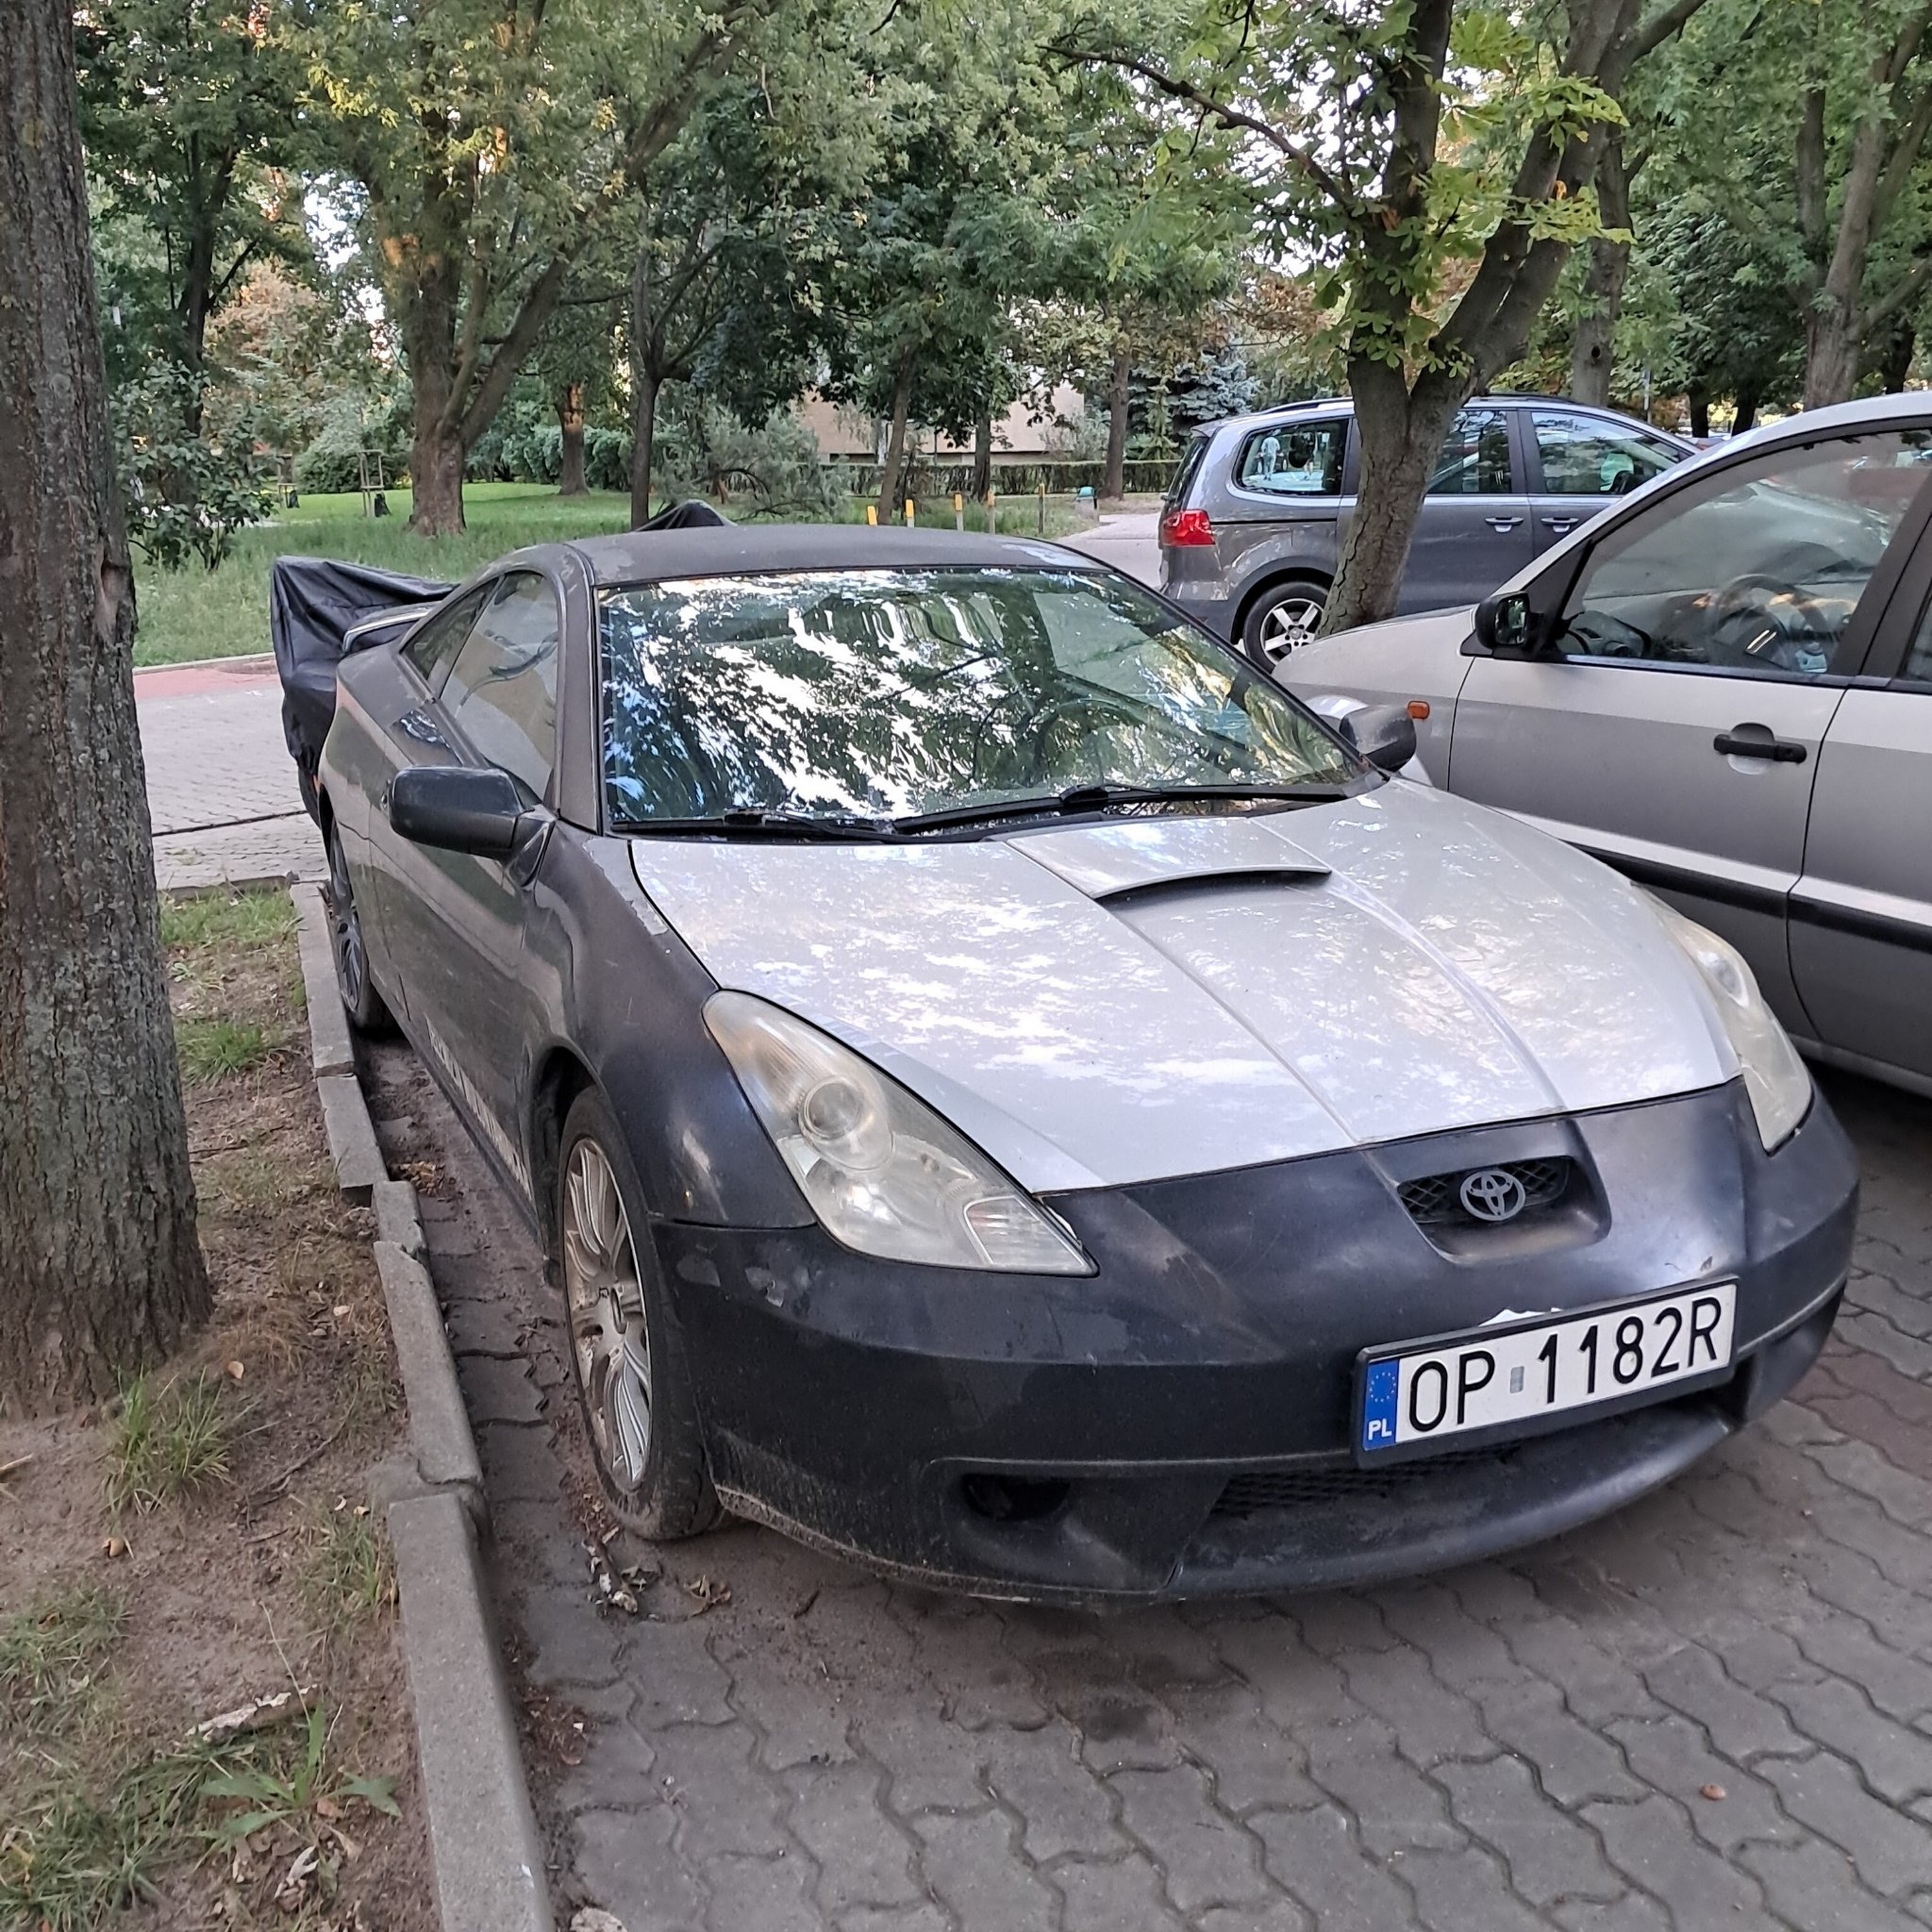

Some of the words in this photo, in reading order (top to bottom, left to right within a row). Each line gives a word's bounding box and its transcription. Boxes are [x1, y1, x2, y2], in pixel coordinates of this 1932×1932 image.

[1408, 1349, 1496, 1432] OP
[1537, 1295, 1723, 1404] 1182R
[1367, 1418, 1393, 1441] PL
